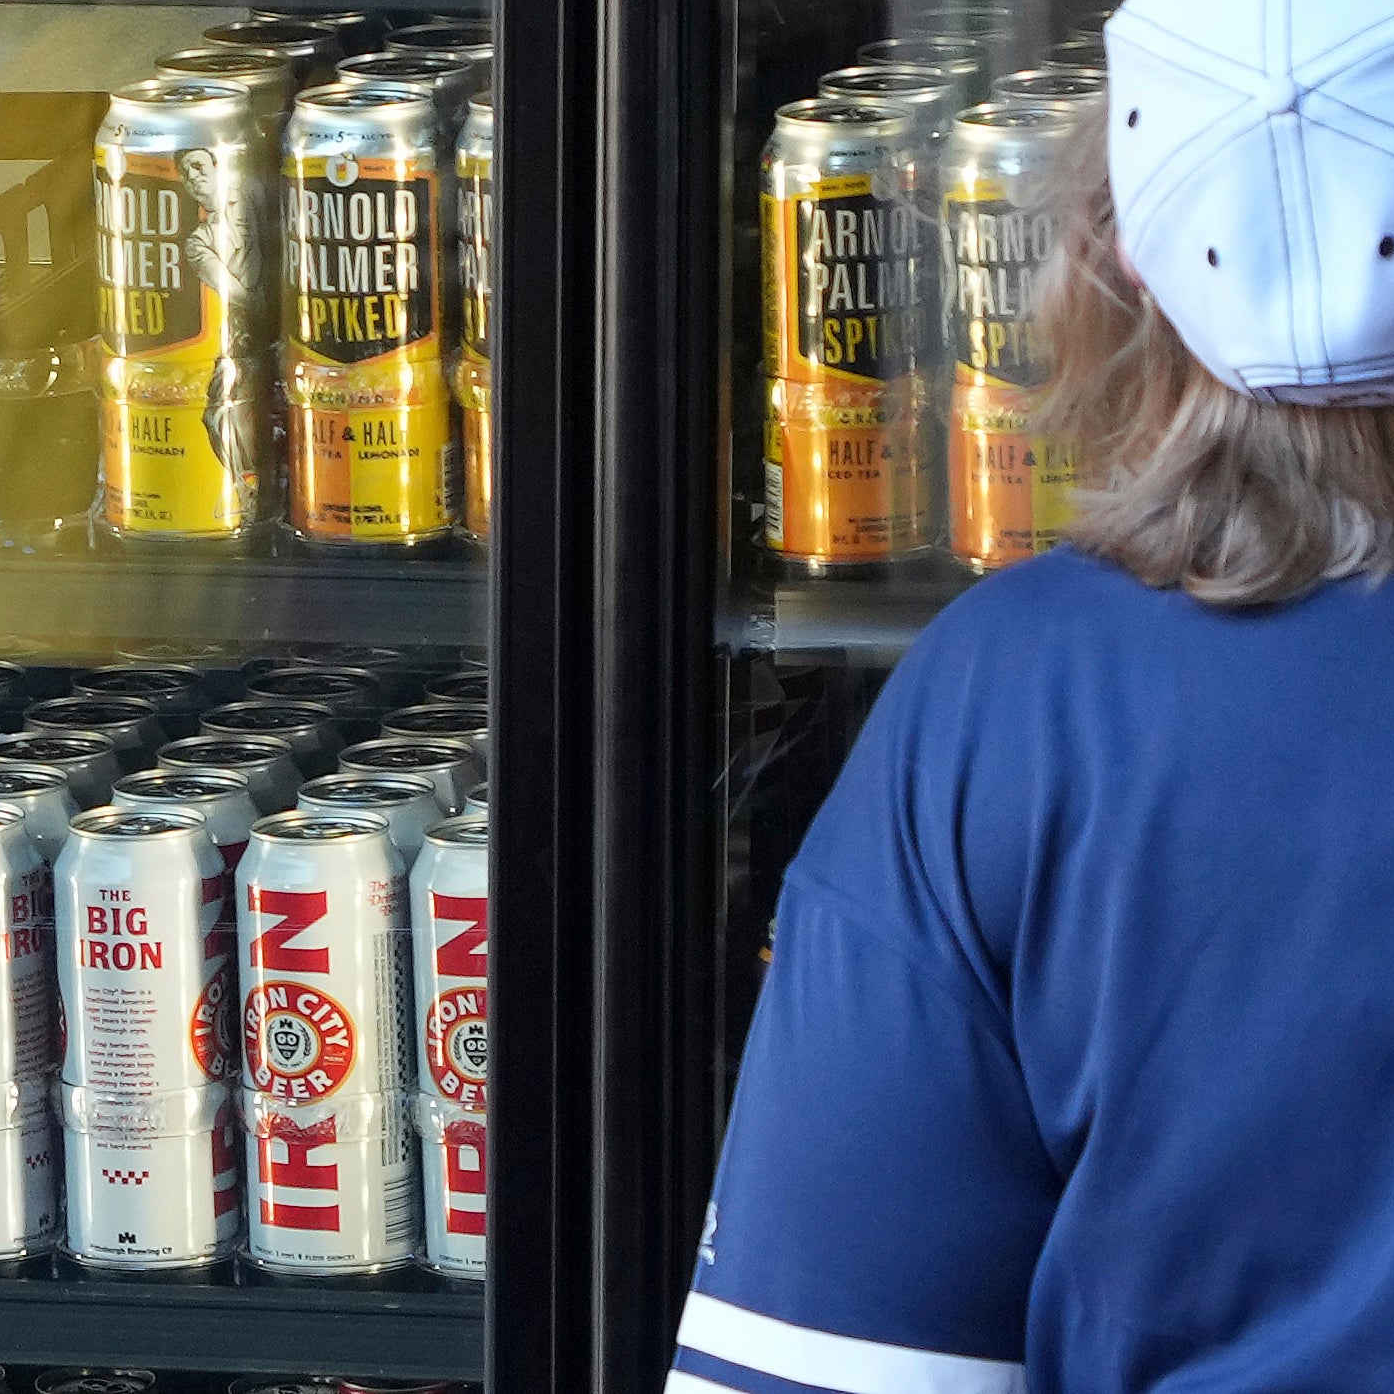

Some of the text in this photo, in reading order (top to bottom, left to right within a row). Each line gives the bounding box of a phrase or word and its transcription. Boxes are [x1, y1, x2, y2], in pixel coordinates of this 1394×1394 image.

[287, 189, 418, 239] ARNOLD
[288, 241, 419, 294] PALMER
[131, 415, 174, 444] HALF
[363, 419, 408, 447] HAL
[357, 448, 420, 461] LEMONADE
[829, 438, 877, 466] HALF
[99, 888, 132, 902] THE
[86, 905, 148, 936] BIG
[79, 938, 163, 971] IRON
[296, 990, 352, 1051] CITY
[251, 1064, 334, 1099] BEER
